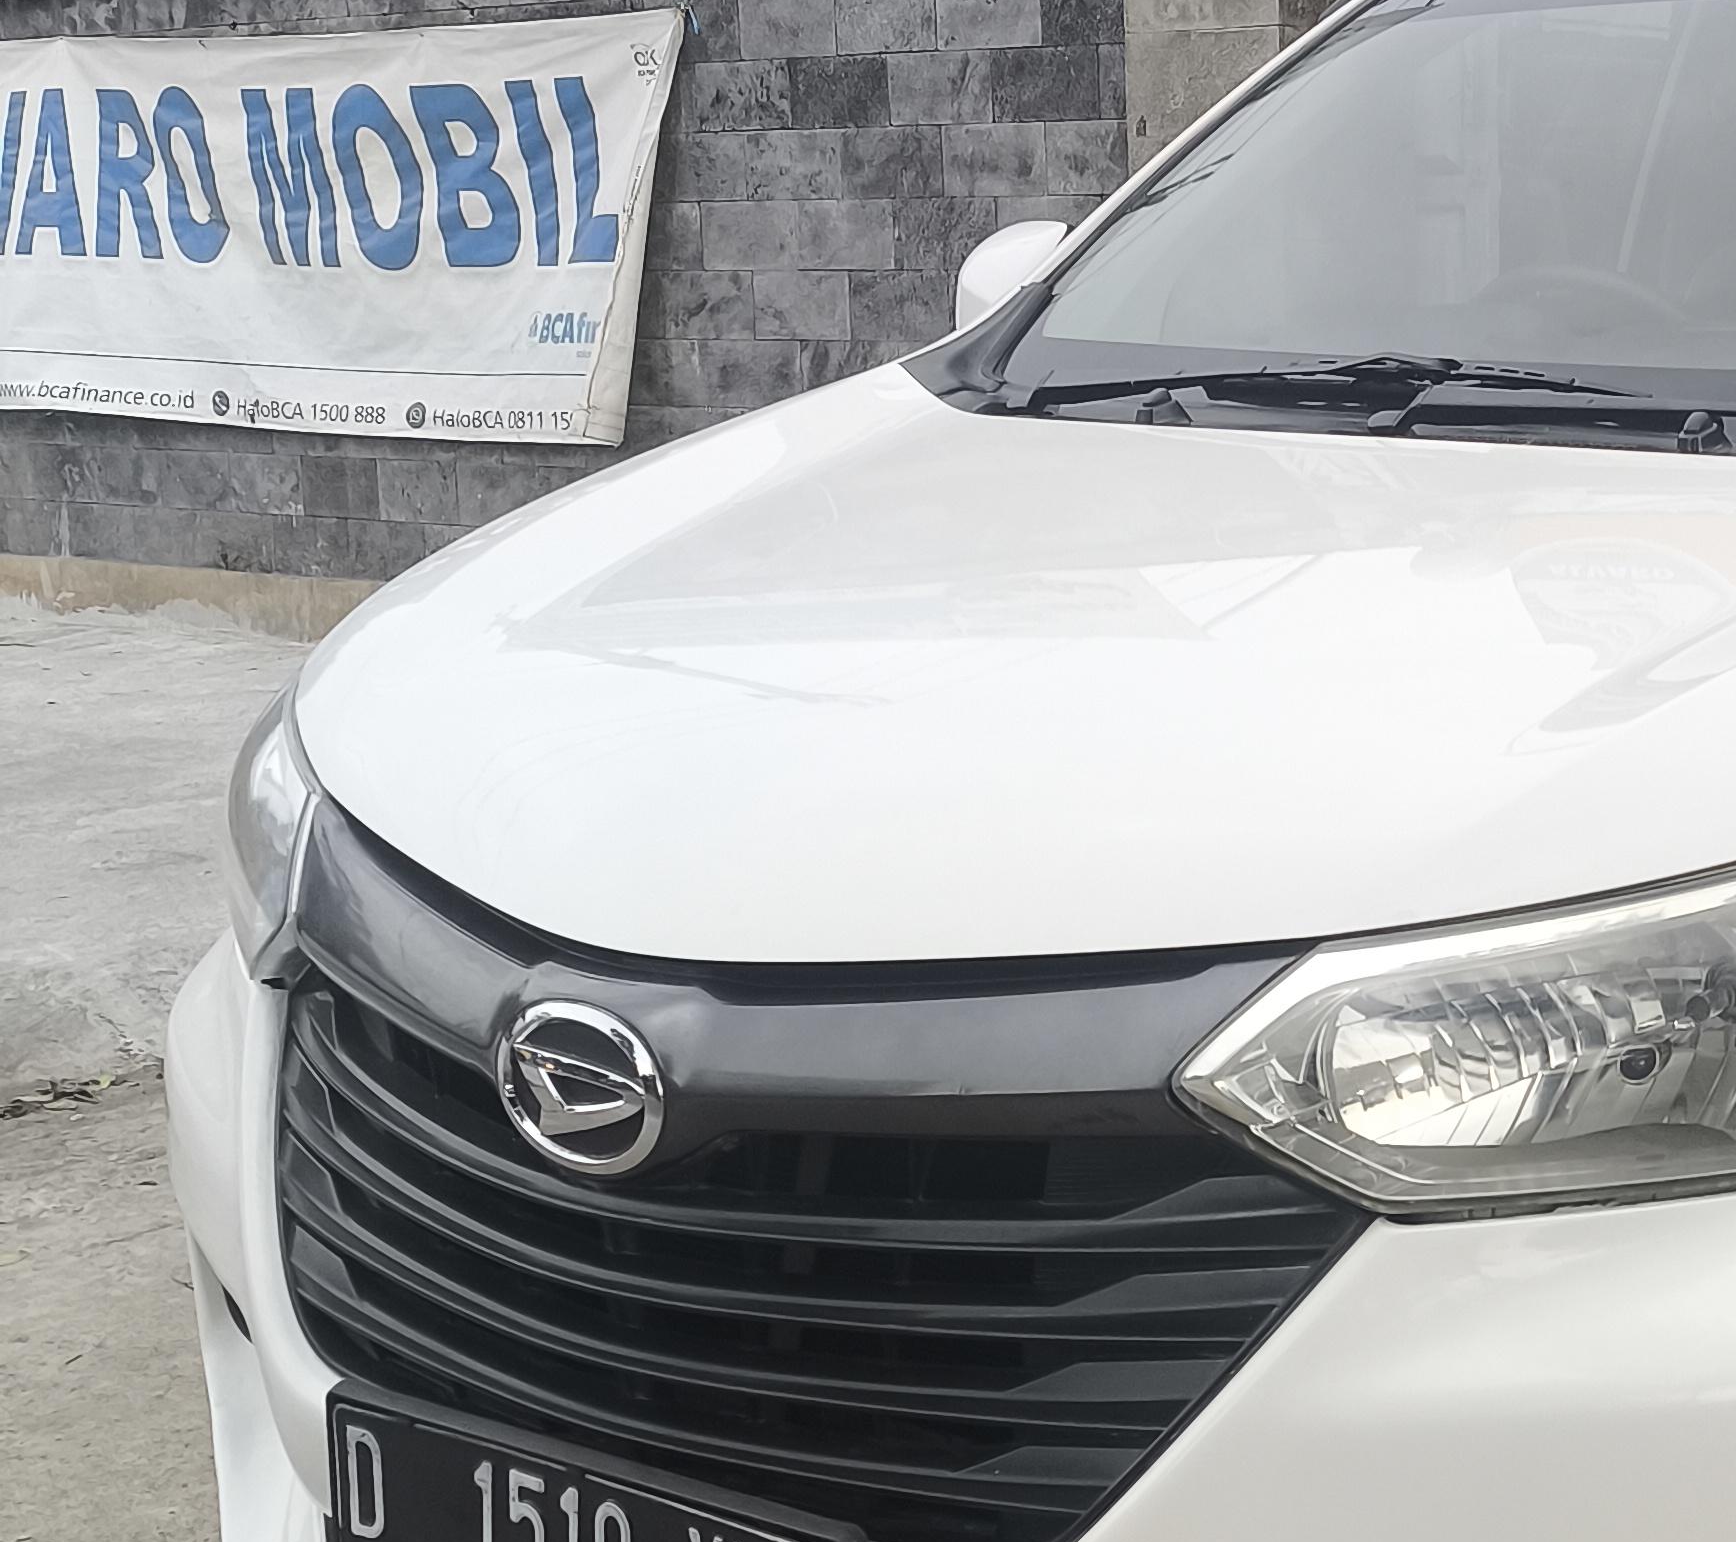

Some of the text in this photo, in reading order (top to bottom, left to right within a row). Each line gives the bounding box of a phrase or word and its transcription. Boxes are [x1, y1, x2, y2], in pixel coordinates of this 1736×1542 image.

[240, 75, 621, 272] MOBIL
[310, 402, 350, 423] 1500
[354, 405, 387, 425] 888
[432, 408, 504, 430] HaloBCA
[508, 410, 544, 430] 0811
[345, 1424, 385, 1540] D
